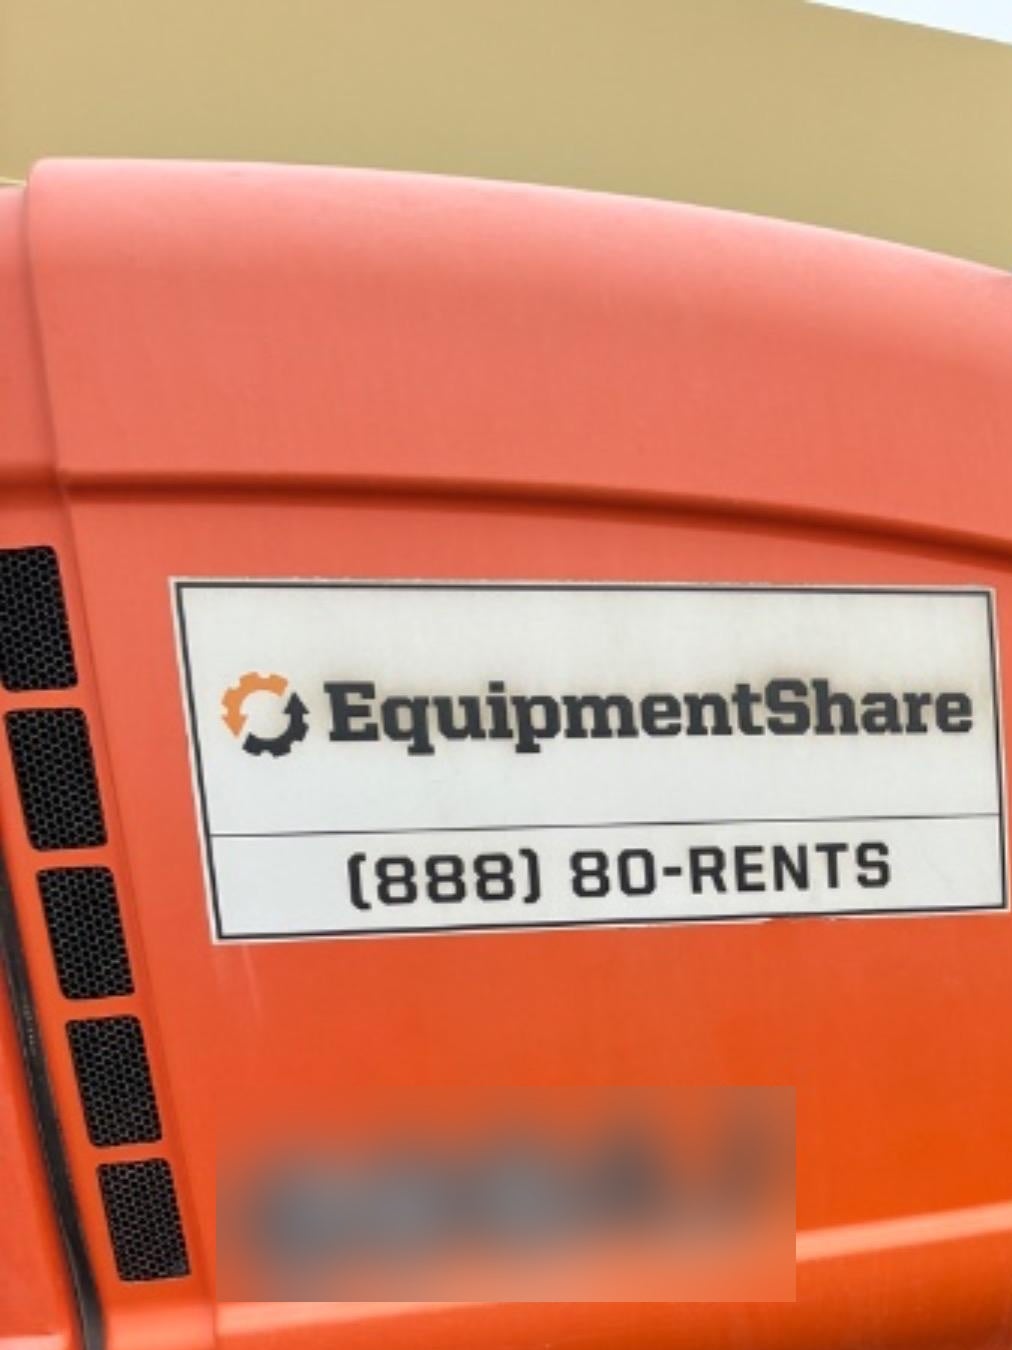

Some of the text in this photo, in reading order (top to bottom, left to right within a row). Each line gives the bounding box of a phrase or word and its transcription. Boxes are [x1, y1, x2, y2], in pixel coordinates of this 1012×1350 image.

[323, 678, 973, 756] EquipmentShare
[347, 841, 892, 910] (888) 80-RENTS
